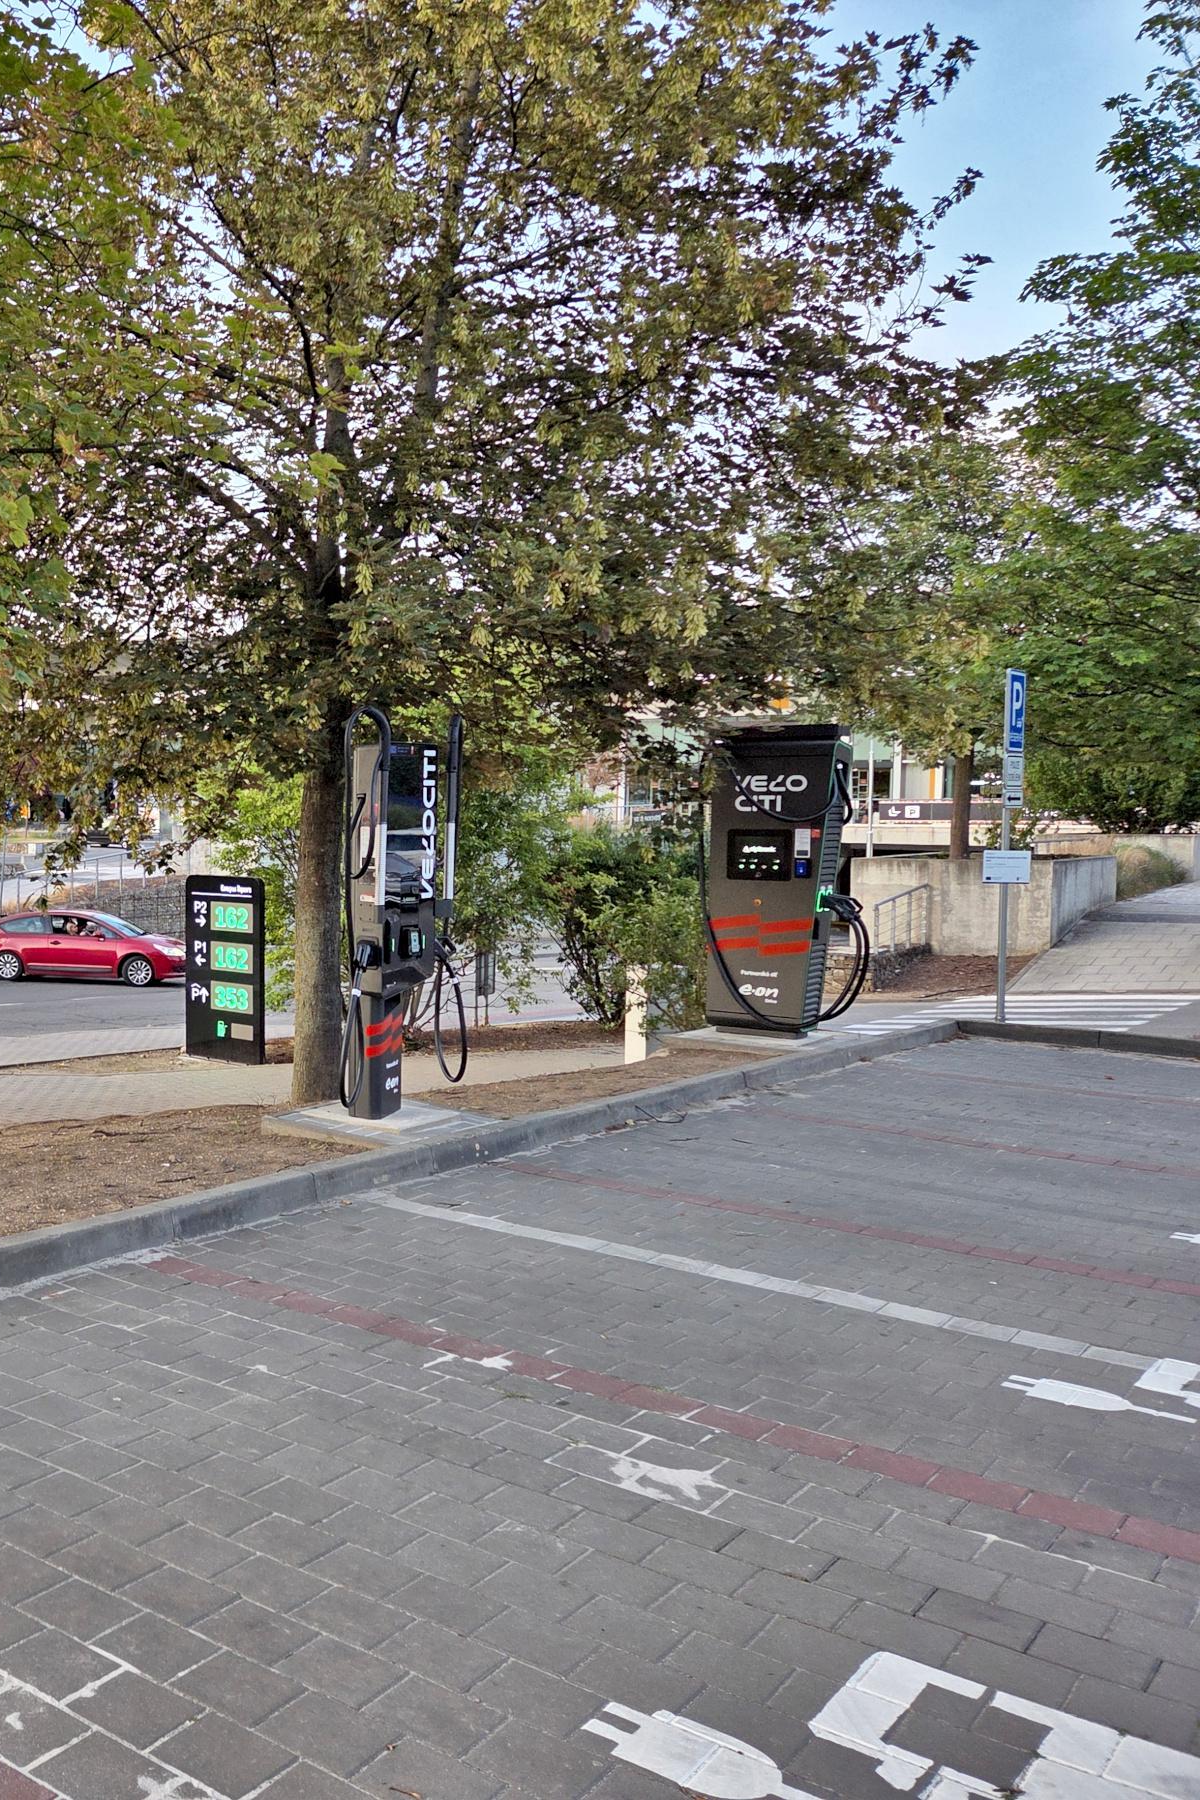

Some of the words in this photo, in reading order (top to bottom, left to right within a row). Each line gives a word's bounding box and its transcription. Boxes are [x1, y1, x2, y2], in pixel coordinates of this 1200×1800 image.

[1011, 681, 1022, 726] P
[735, 774, 808, 792] VELO
[420, 749, 437, 899] VELOCITI
[194, 900, 207, 914] P2
[215, 905, 249, 930] 162
[194, 940, 207, 954] P1
[215, 946, 249, 970] 162
[215, 986, 248, 1010] 353
